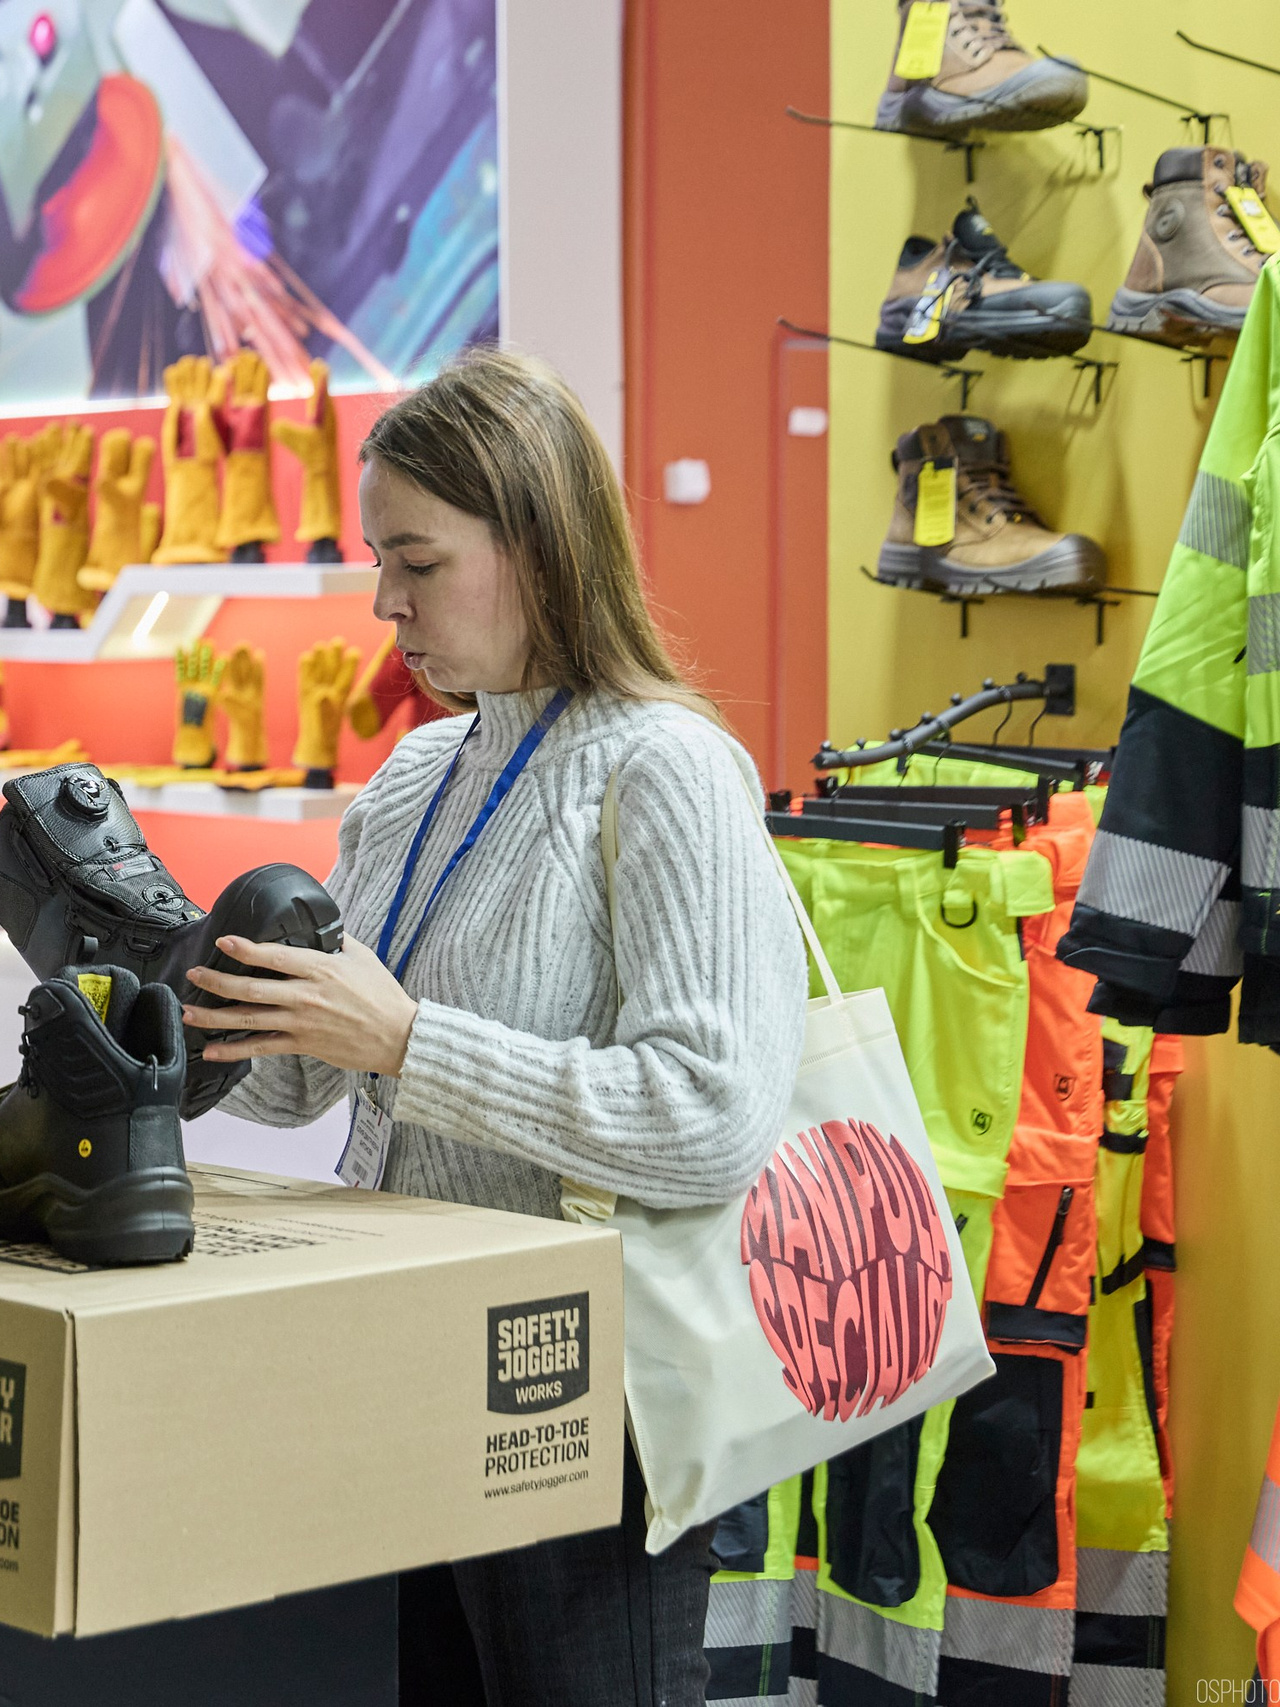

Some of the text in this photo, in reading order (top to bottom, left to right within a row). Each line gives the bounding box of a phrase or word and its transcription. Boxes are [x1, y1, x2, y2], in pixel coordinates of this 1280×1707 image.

[741, 1116, 952, 1281] MANIPULA
[497, 1307, 580, 1350] SAFETY
[749, 1254, 953, 1424] SPECIALIST
[497, 1339, 580, 1383] JOGGER
[515, 1380, 562, 1405] WORKS
[486, 1417, 589, 1454] HEAD-TO-TOE
[485, 1438, 589, 1478] PROTECTION
[484, 1468, 589, 1499] www.safetyjogger.com
